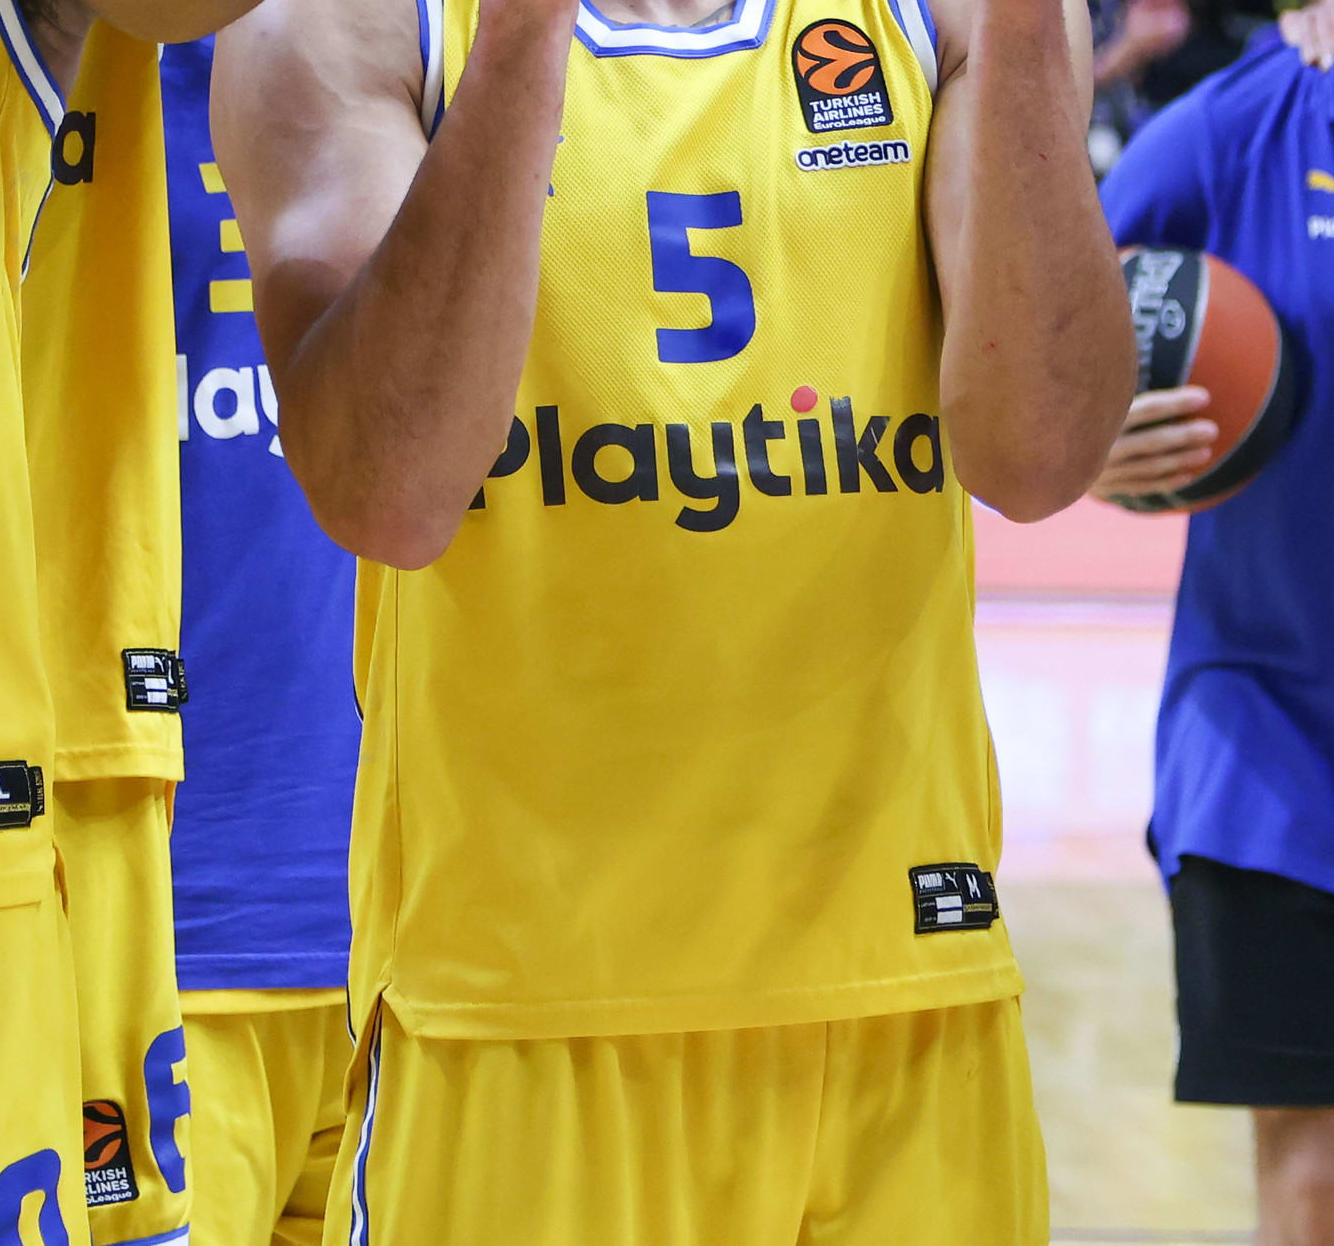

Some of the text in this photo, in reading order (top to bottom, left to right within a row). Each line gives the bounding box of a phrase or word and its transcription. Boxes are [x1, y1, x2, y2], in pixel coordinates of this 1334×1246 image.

[809, 91, 882, 113] TURKISH
[813, 103, 884, 123] AIRLINES
[814, 115, 886, 130] EuroLeague
[797, 141, 909, 168] oneteam
[646, 190, 757, 364] 5
[918, 872, 943, 890] PUMA
[965, 873, 982, 899] M
